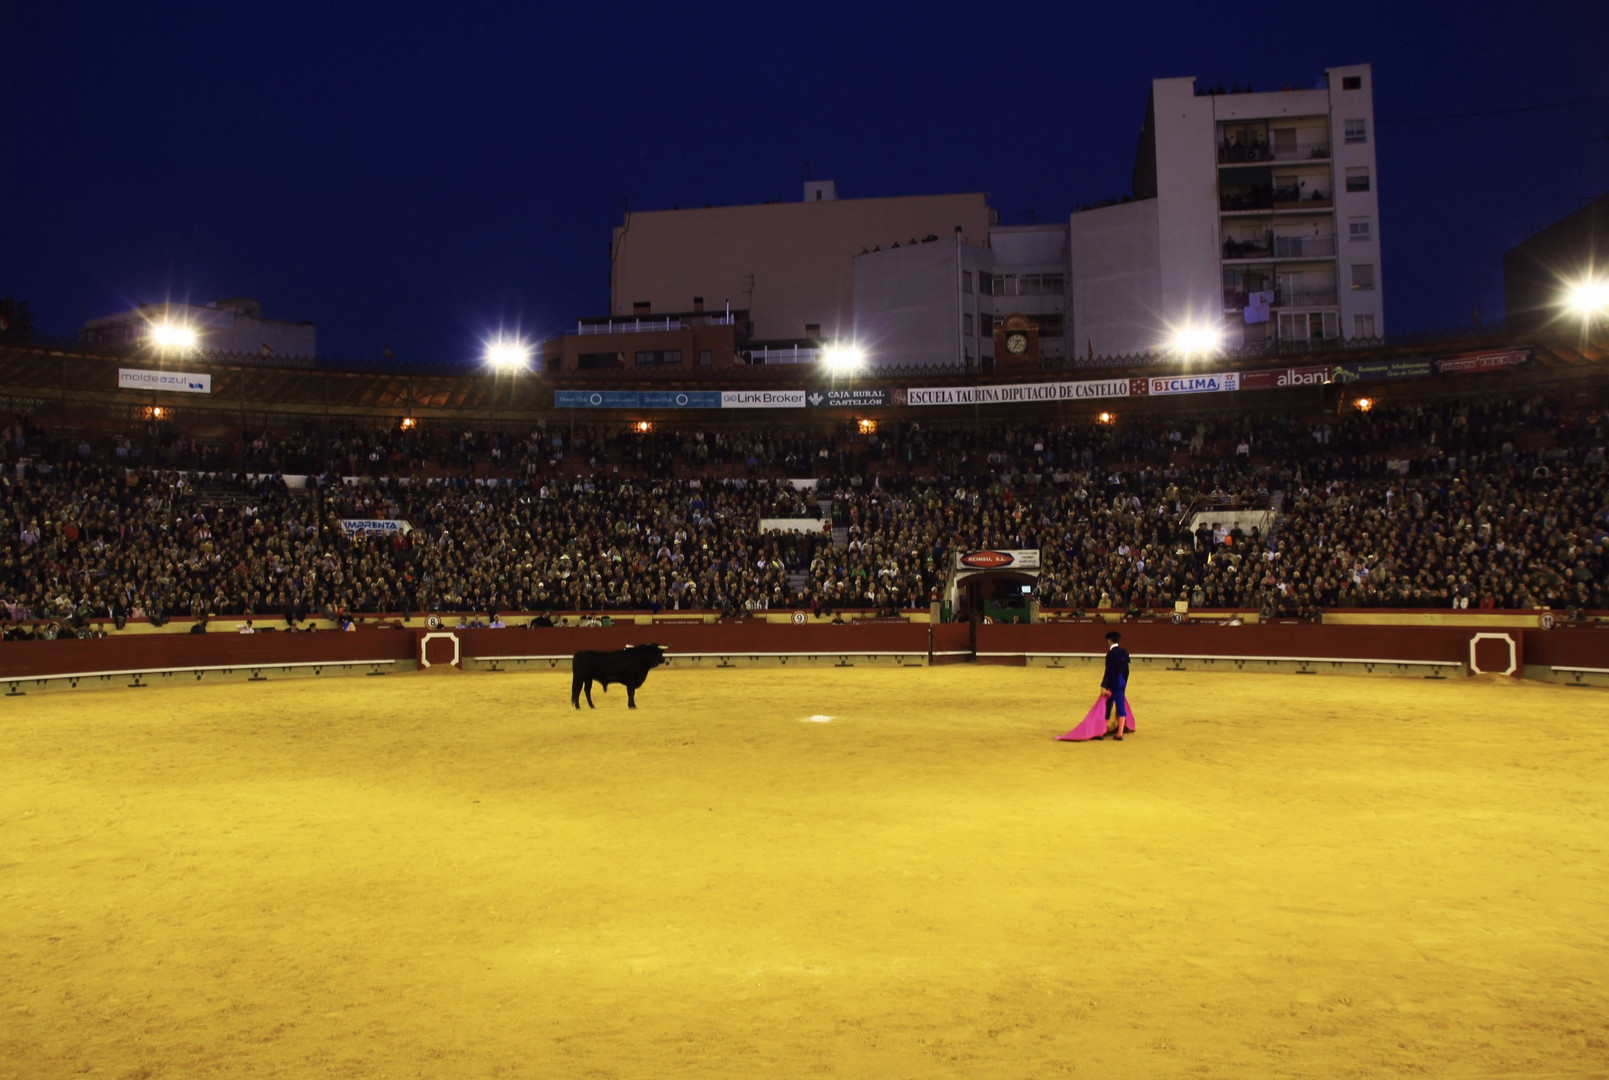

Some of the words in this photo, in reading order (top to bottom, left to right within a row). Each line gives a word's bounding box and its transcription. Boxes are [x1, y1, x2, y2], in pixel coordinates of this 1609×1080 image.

[121, 373, 186, 384] moldeazul
[1278, 368, 1329, 386] albani
[909, 390, 953, 404] ESCUELA
[954, 388, 999, 402] TAURINA
[1001, 384, 1057, 401] DIPUTACIÓ
[1059, 385, 1074, 398] DE
[1075, 380, 1128, 397] CASTELLÓ
[1154, 378, 1217, 393] BICLIMA
[829, 398, 882, 406] CASTELLÓN
[345, 521, 397, 530] IMPRENTA
